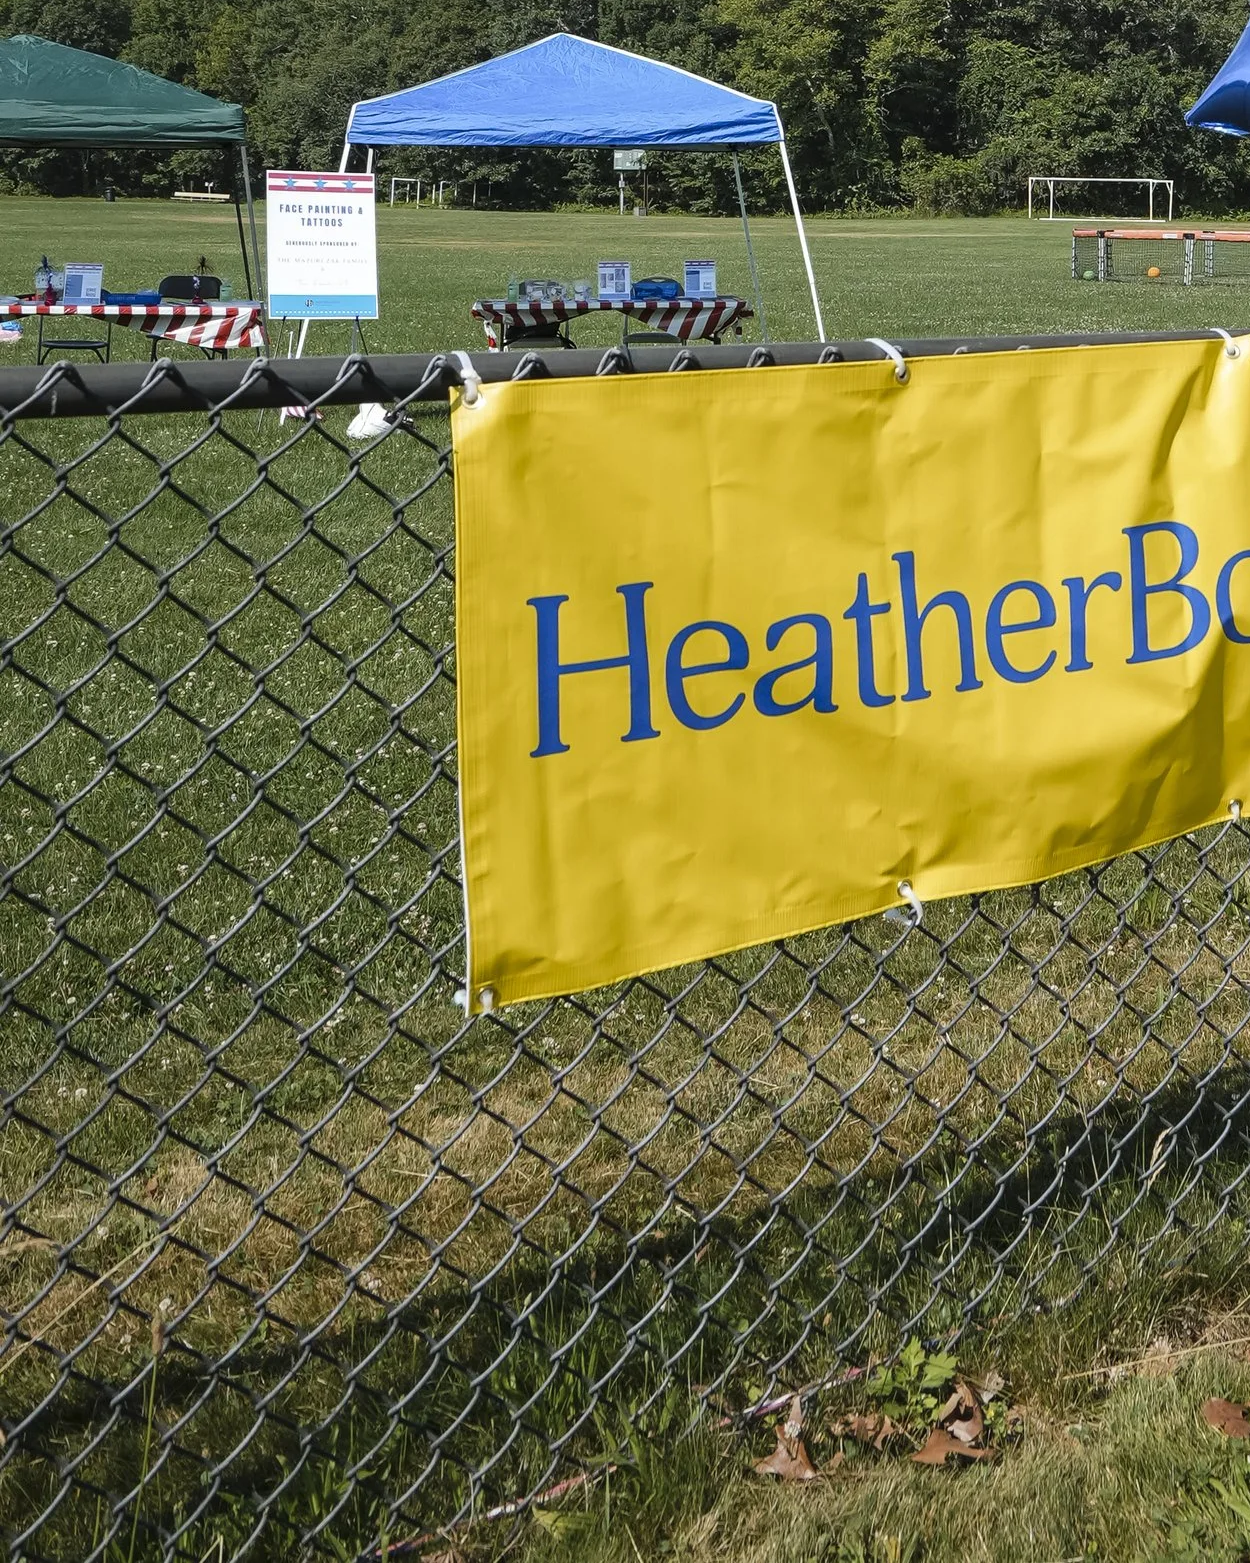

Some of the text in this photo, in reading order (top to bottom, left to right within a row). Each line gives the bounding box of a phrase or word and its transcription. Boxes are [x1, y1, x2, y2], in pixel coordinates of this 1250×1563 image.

[279, 203, 303, 214] FACE
[308, 205, 353, 214] PAINTING
[301, 218, 343, 227] TATTOOS
